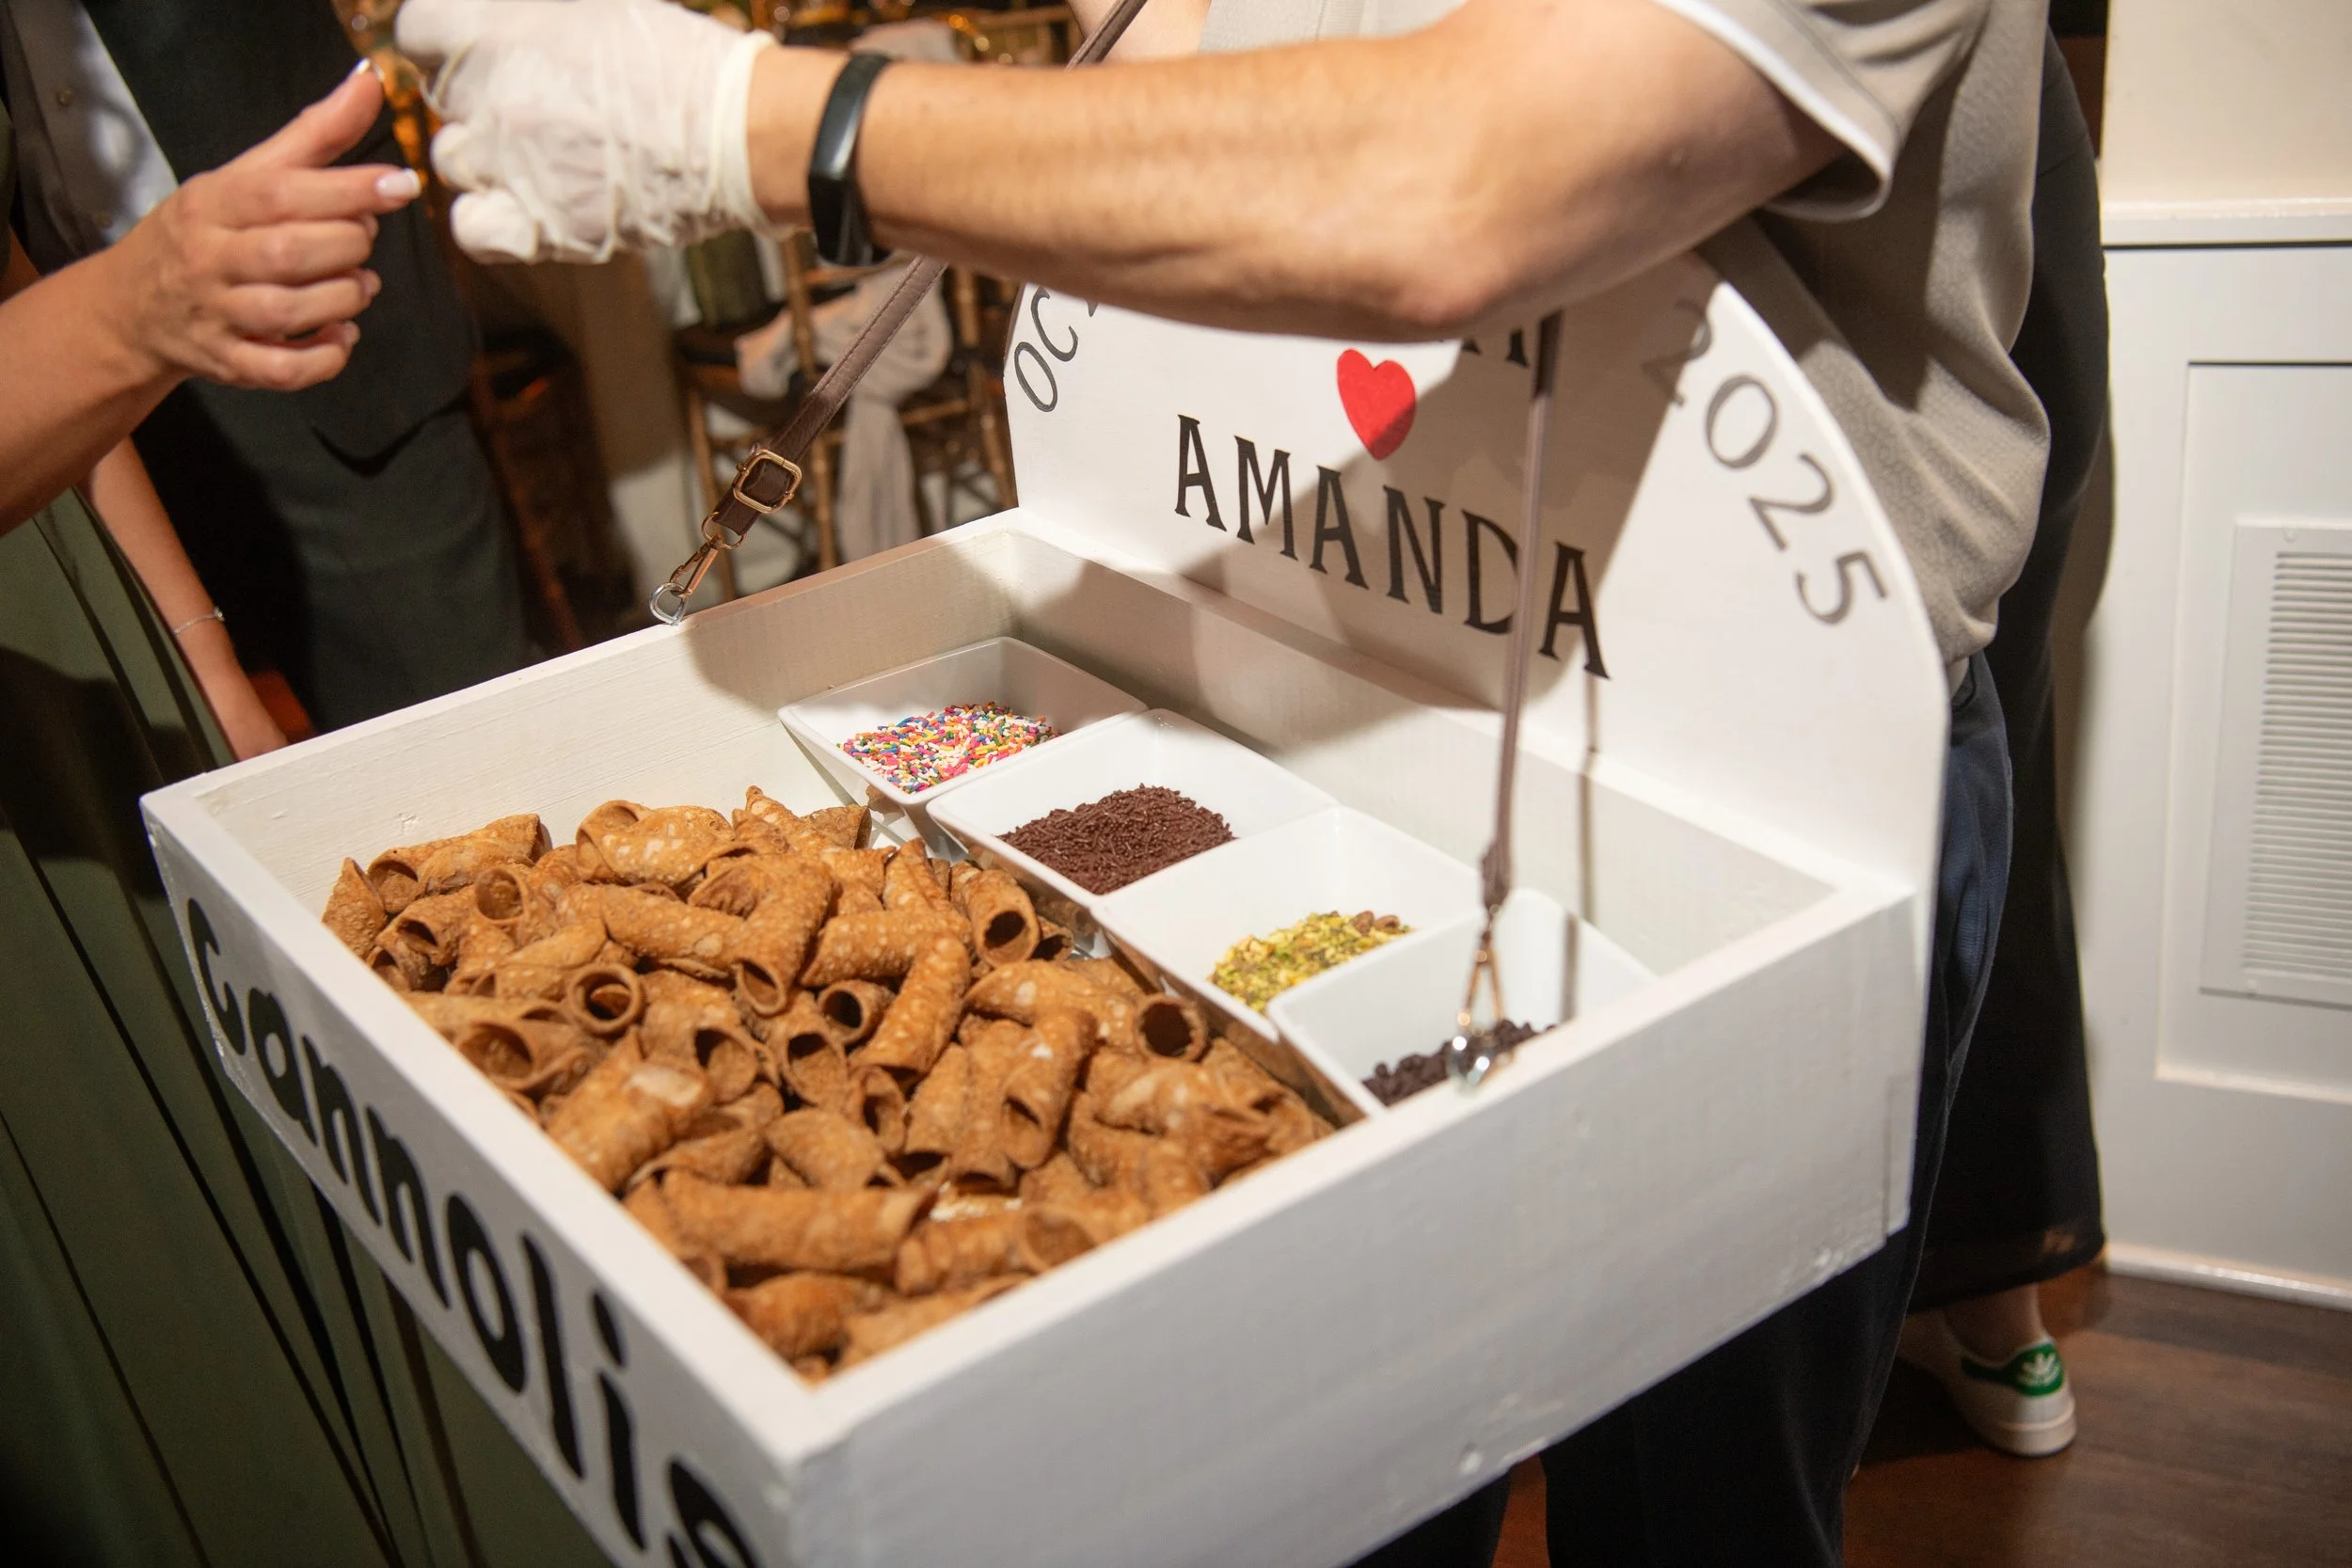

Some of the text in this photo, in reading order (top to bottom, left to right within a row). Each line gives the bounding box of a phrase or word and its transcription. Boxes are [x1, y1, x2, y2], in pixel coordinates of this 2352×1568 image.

[1013, 285, 1099, 413] OC
[1639, 297, 1888, 626] 2025
[1174, 414, 1611, 680] AMANDA
